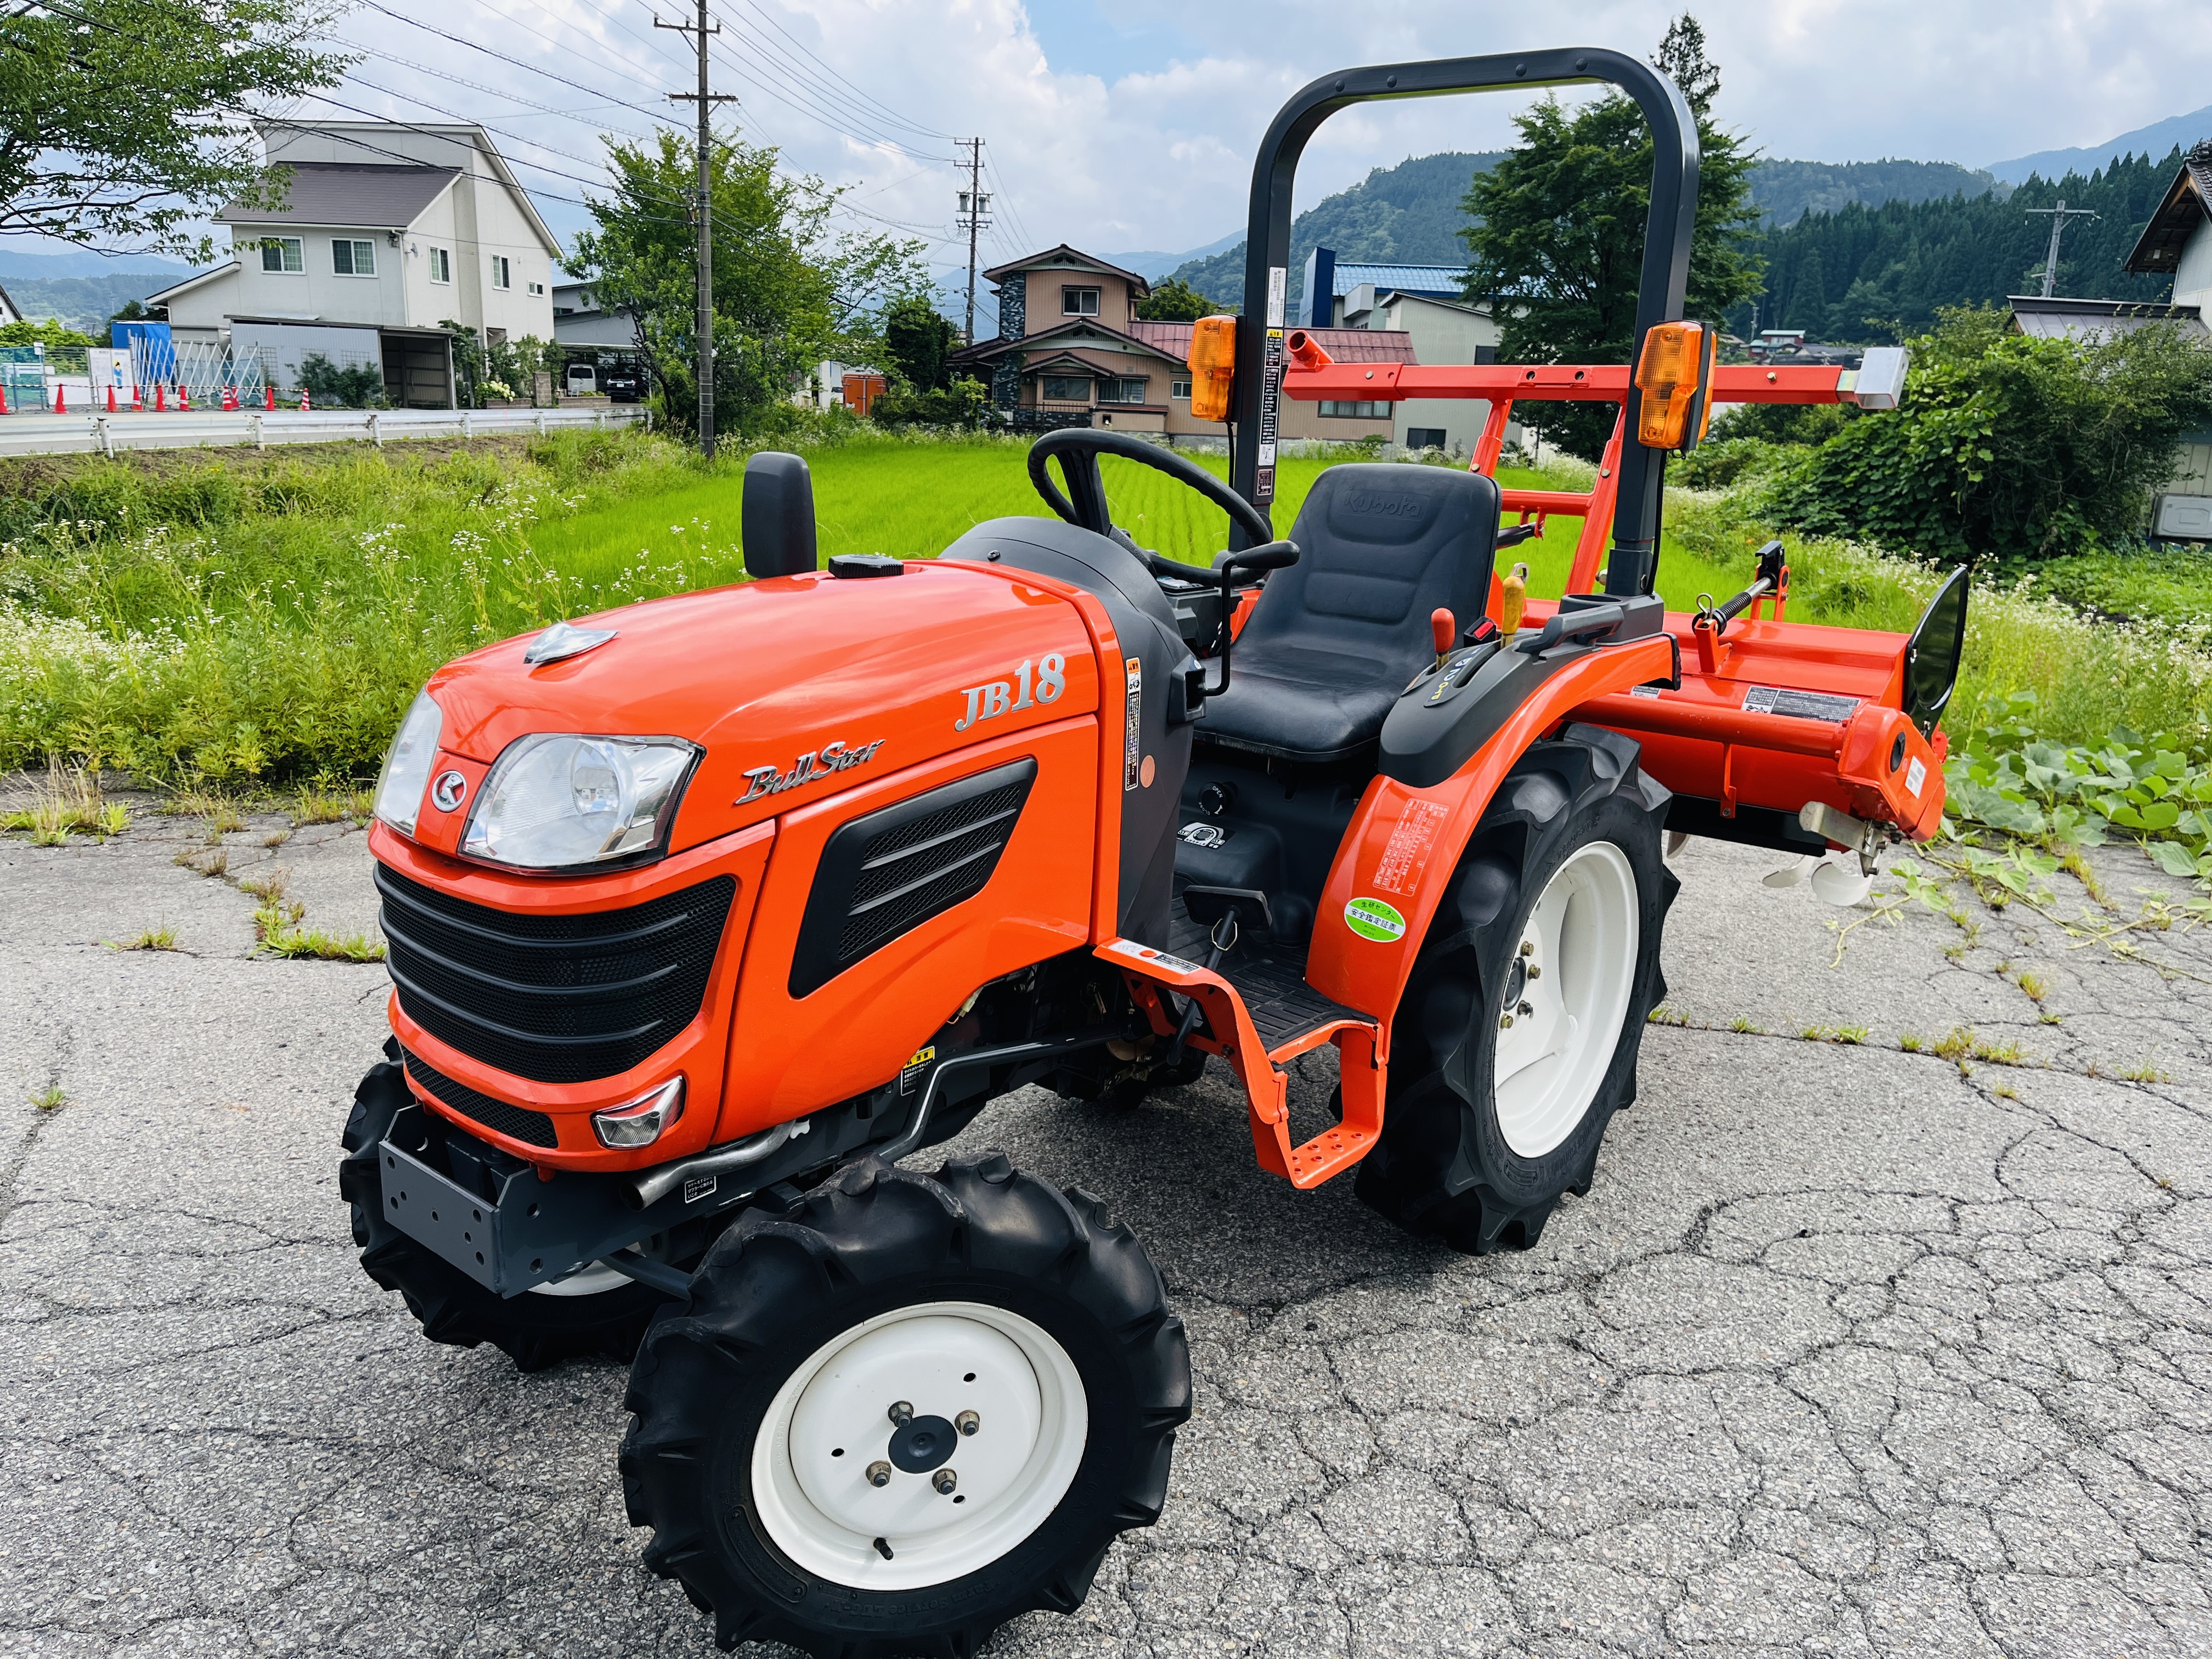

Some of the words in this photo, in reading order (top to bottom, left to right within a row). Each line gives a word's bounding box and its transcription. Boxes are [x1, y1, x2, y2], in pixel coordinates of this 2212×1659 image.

[1345, 493, 1421, 517] Kubota
[954, 653, 1065, 732] JB18
[1431, 681, 1449, 701] PTO
[1212, 786, 1223, 798] OPEN
[1198, 802, 1210, 815] CLOSE
[1351, 909, 1397, 932] 安全鑑定証票
[1361, 901, 1395, 919] 生研センター
[885, 1595, 949, 1618] Service
